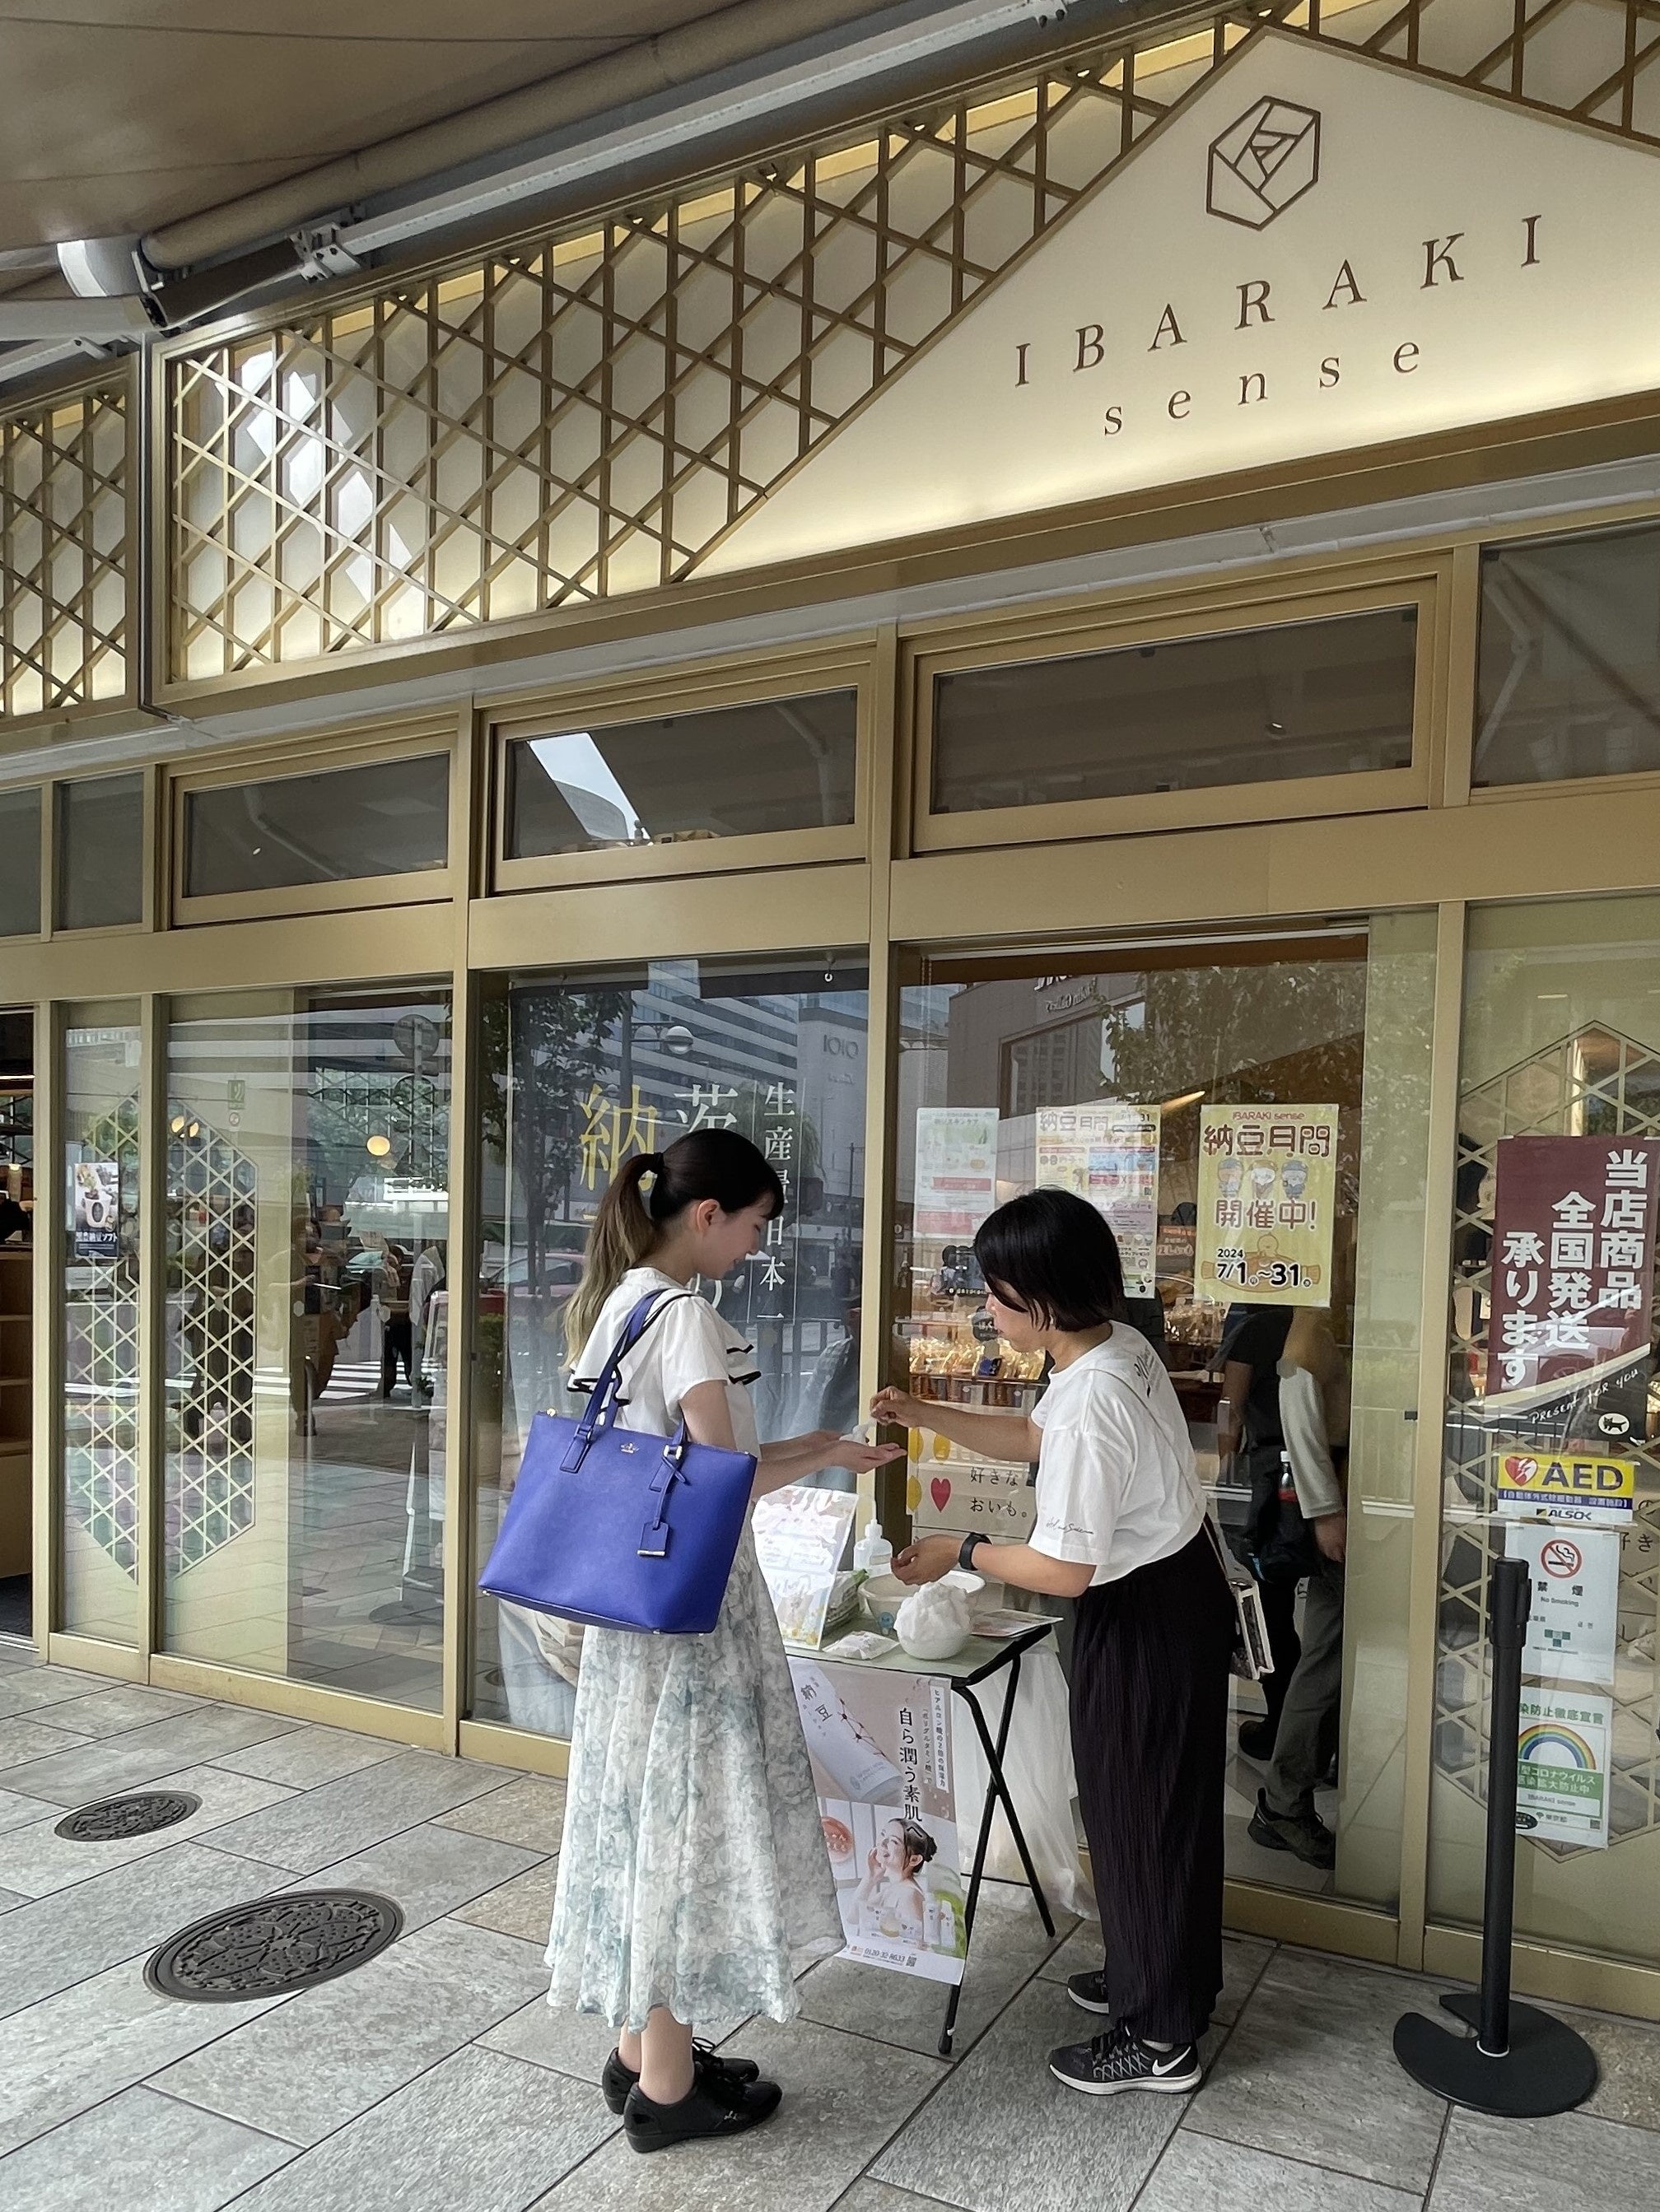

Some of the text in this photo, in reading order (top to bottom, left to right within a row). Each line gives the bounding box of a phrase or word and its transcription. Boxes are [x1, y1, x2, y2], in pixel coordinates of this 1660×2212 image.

[1014, 215, 1543, 388] IBARAKI
[1104, 341, 1421, 435] sense
[1233, 1111, 1305, 1120] IBARAKI sense
[579, 1083, 659, 1221] 納
[1203, 1124, 1331, 1157] 納豆月間
[1215, 1199, 1316, 1230] 開催中!
[1598, 1149, 1648, 1310] 当店商品
[1217, 1248, 1244, 1258] 2024
[1545, 1190, 1596, 1350] 全国発送
[1497, 1232, 1546, 1386] 承ります
[970, 1466, 1019, 1487] 好きな
[1542, 1462, 1623, 1491] AED
[970, 1497, 1028, 1518] おいも。
[1548, 1509, 1592, 1521] ALSOK
[1550, 1597, 1579, 1608] Smoking
[899, 1707, 923, 1838] 自ら潤う素肌へ
[1519, 1765, 1596, 1785] 型コロナウイルス
